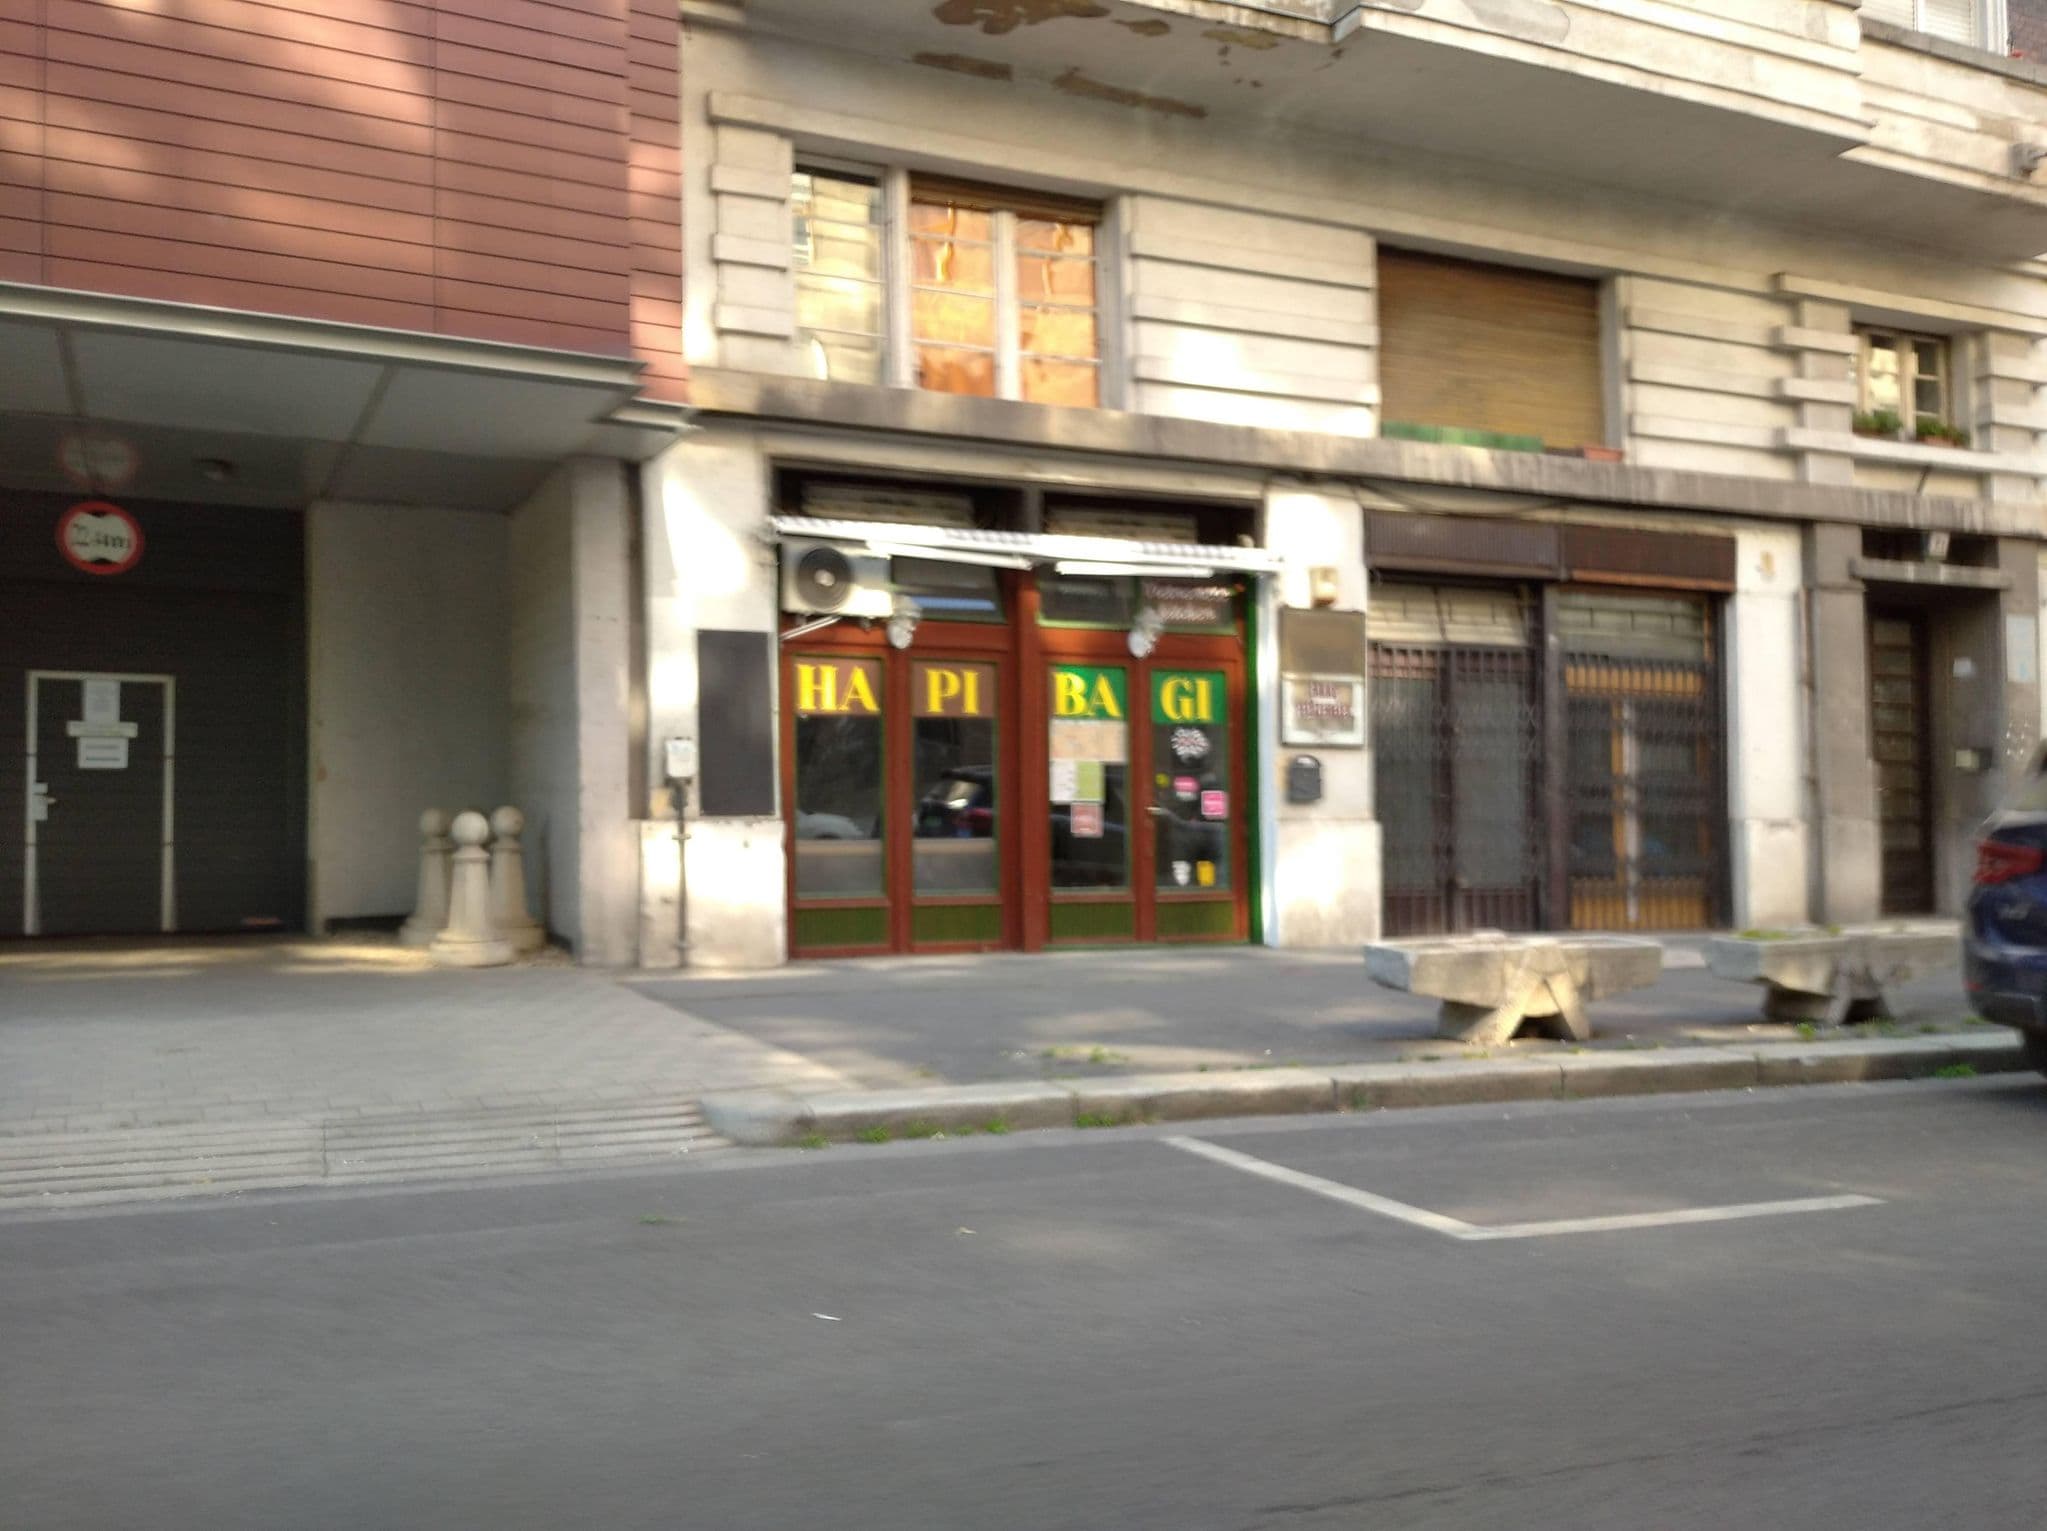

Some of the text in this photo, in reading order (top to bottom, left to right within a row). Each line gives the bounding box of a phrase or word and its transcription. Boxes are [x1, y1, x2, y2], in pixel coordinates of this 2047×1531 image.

[796, 663, 1212, 721] HA PI BA GI
